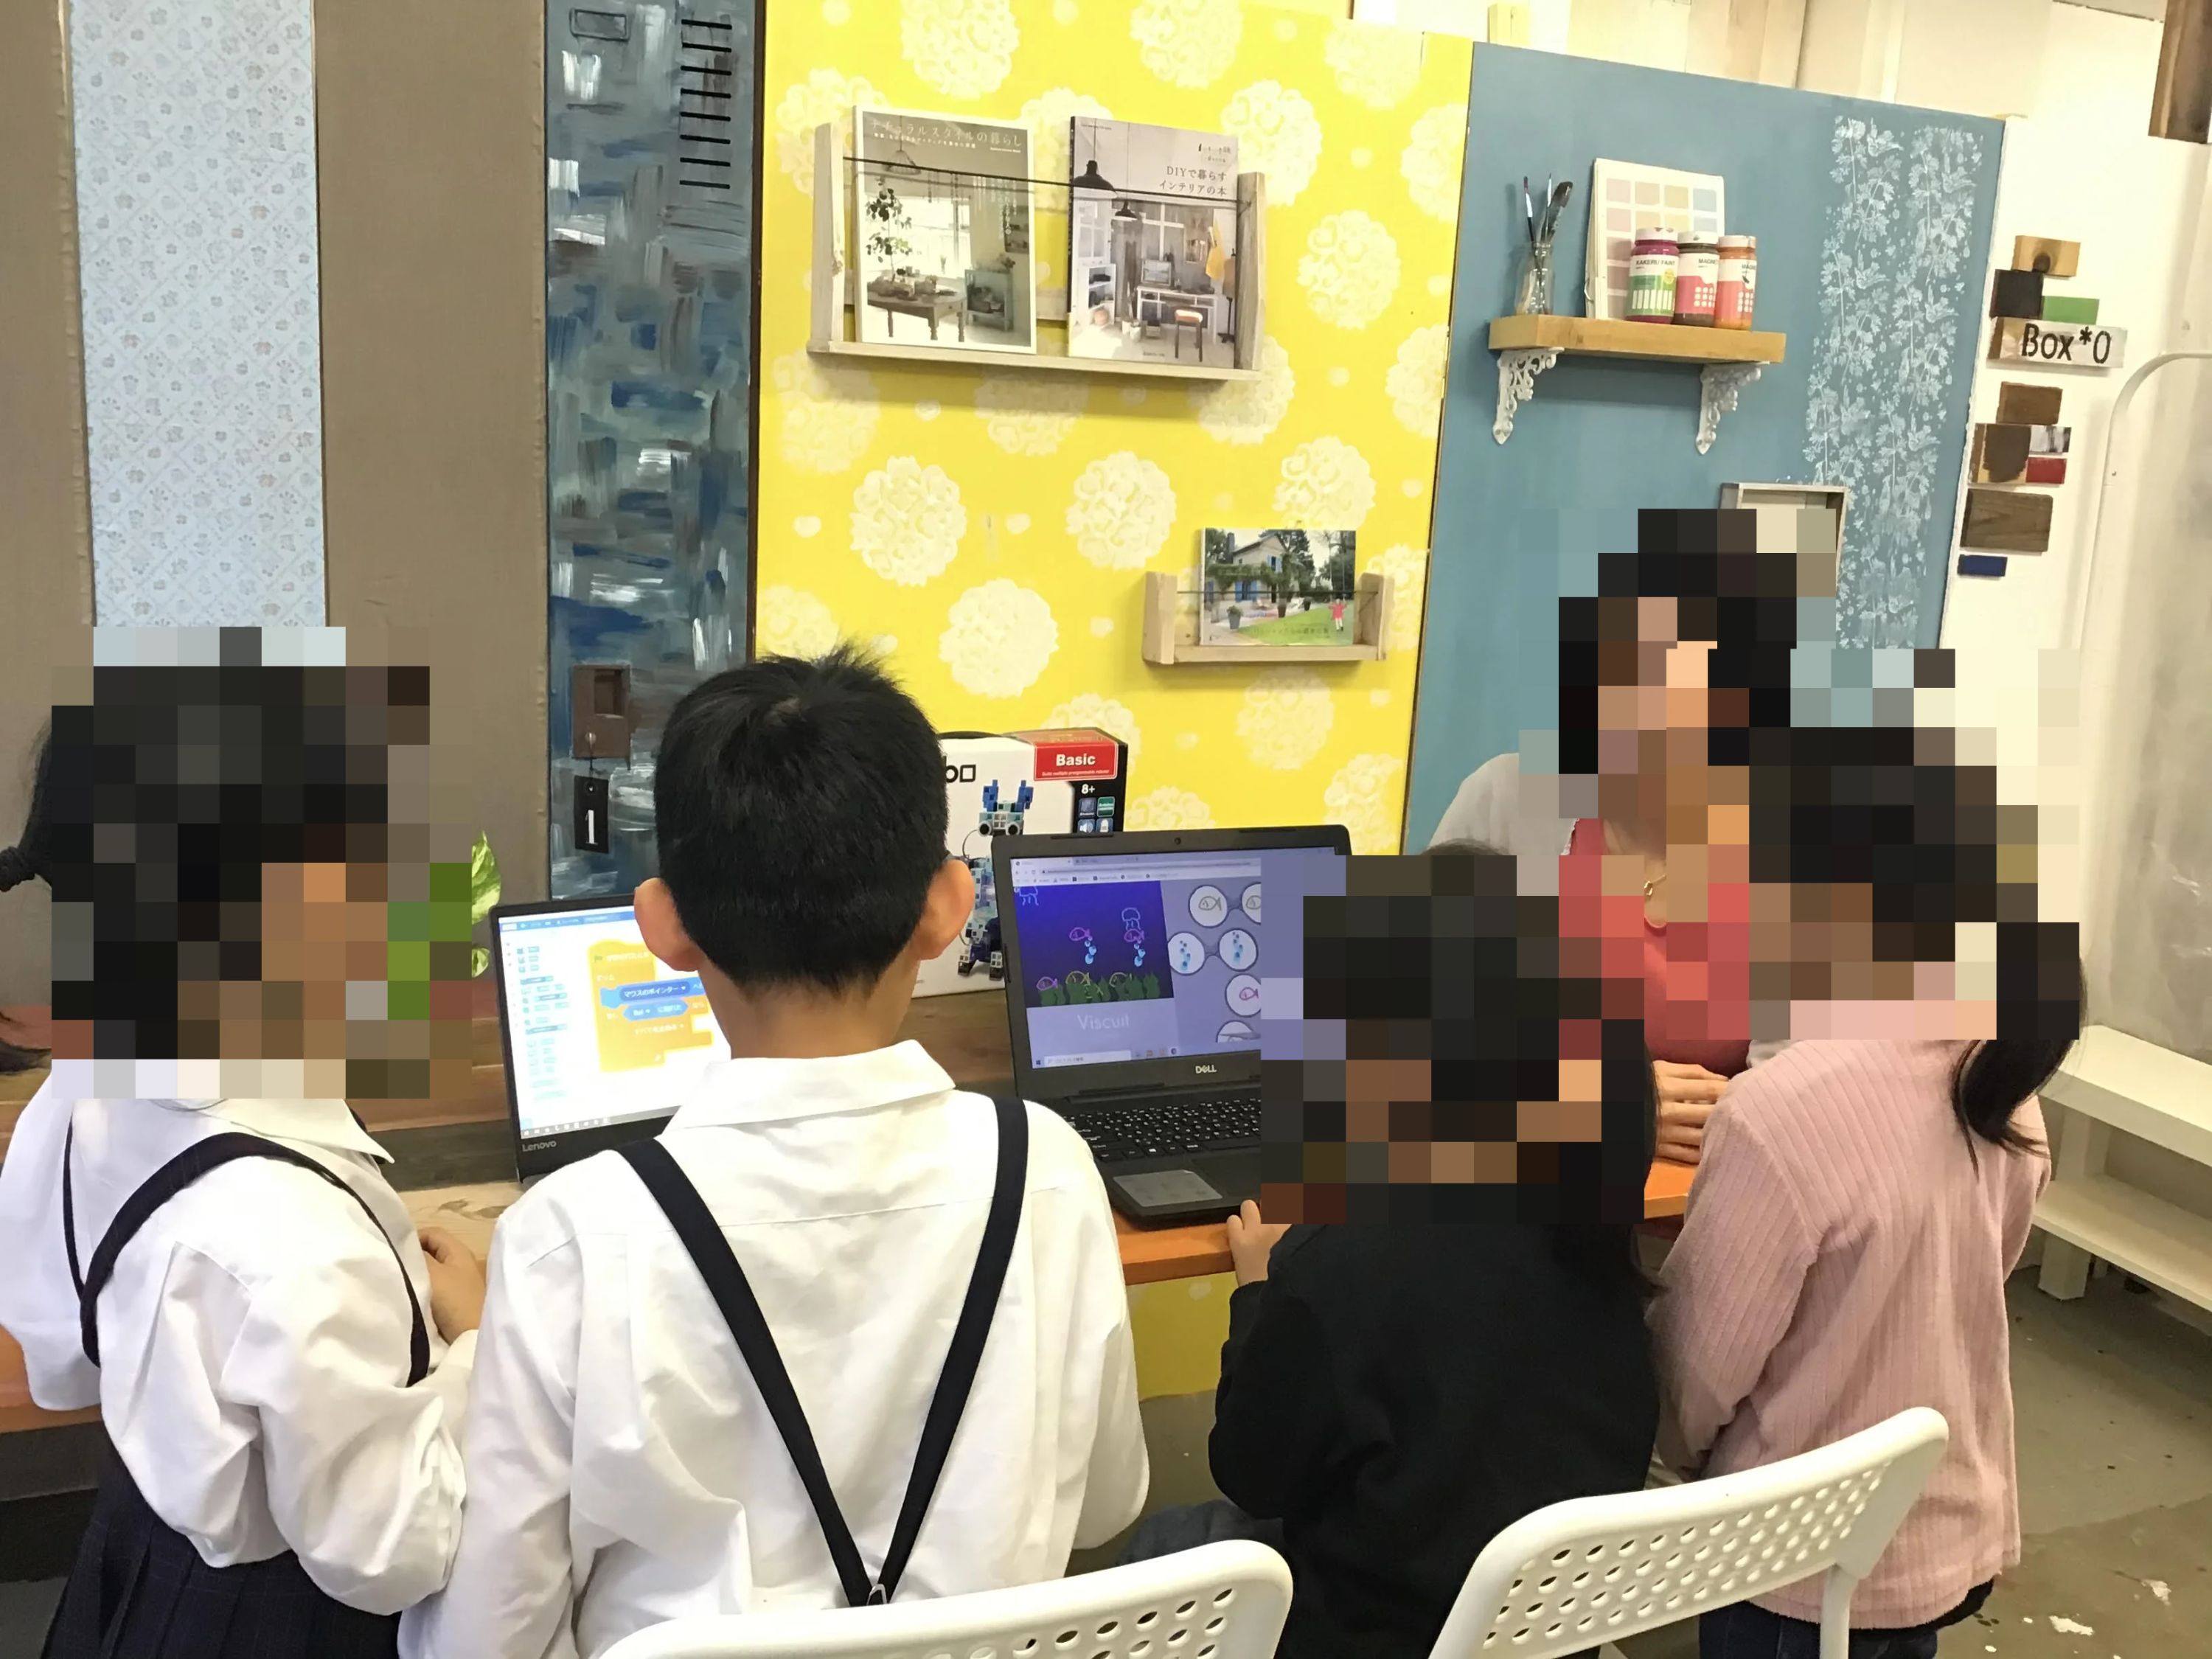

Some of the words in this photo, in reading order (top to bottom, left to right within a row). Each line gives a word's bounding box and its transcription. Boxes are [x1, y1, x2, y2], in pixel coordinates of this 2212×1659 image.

[1167, 166, 1226, 181] DIYで暮らす
[1160, 179, 1226, 196] インテリアの本
[1056, 753, 1096, 766] Basic
[1081, 783, 1096, 795] 8+
[585, 809, 598, 845] 1
[1077, 1013, 1130, 1031] Viscuit
[1195, 1064, 1217, 1074] DELL
[522, 1140, 557, 1152] Lenovo
